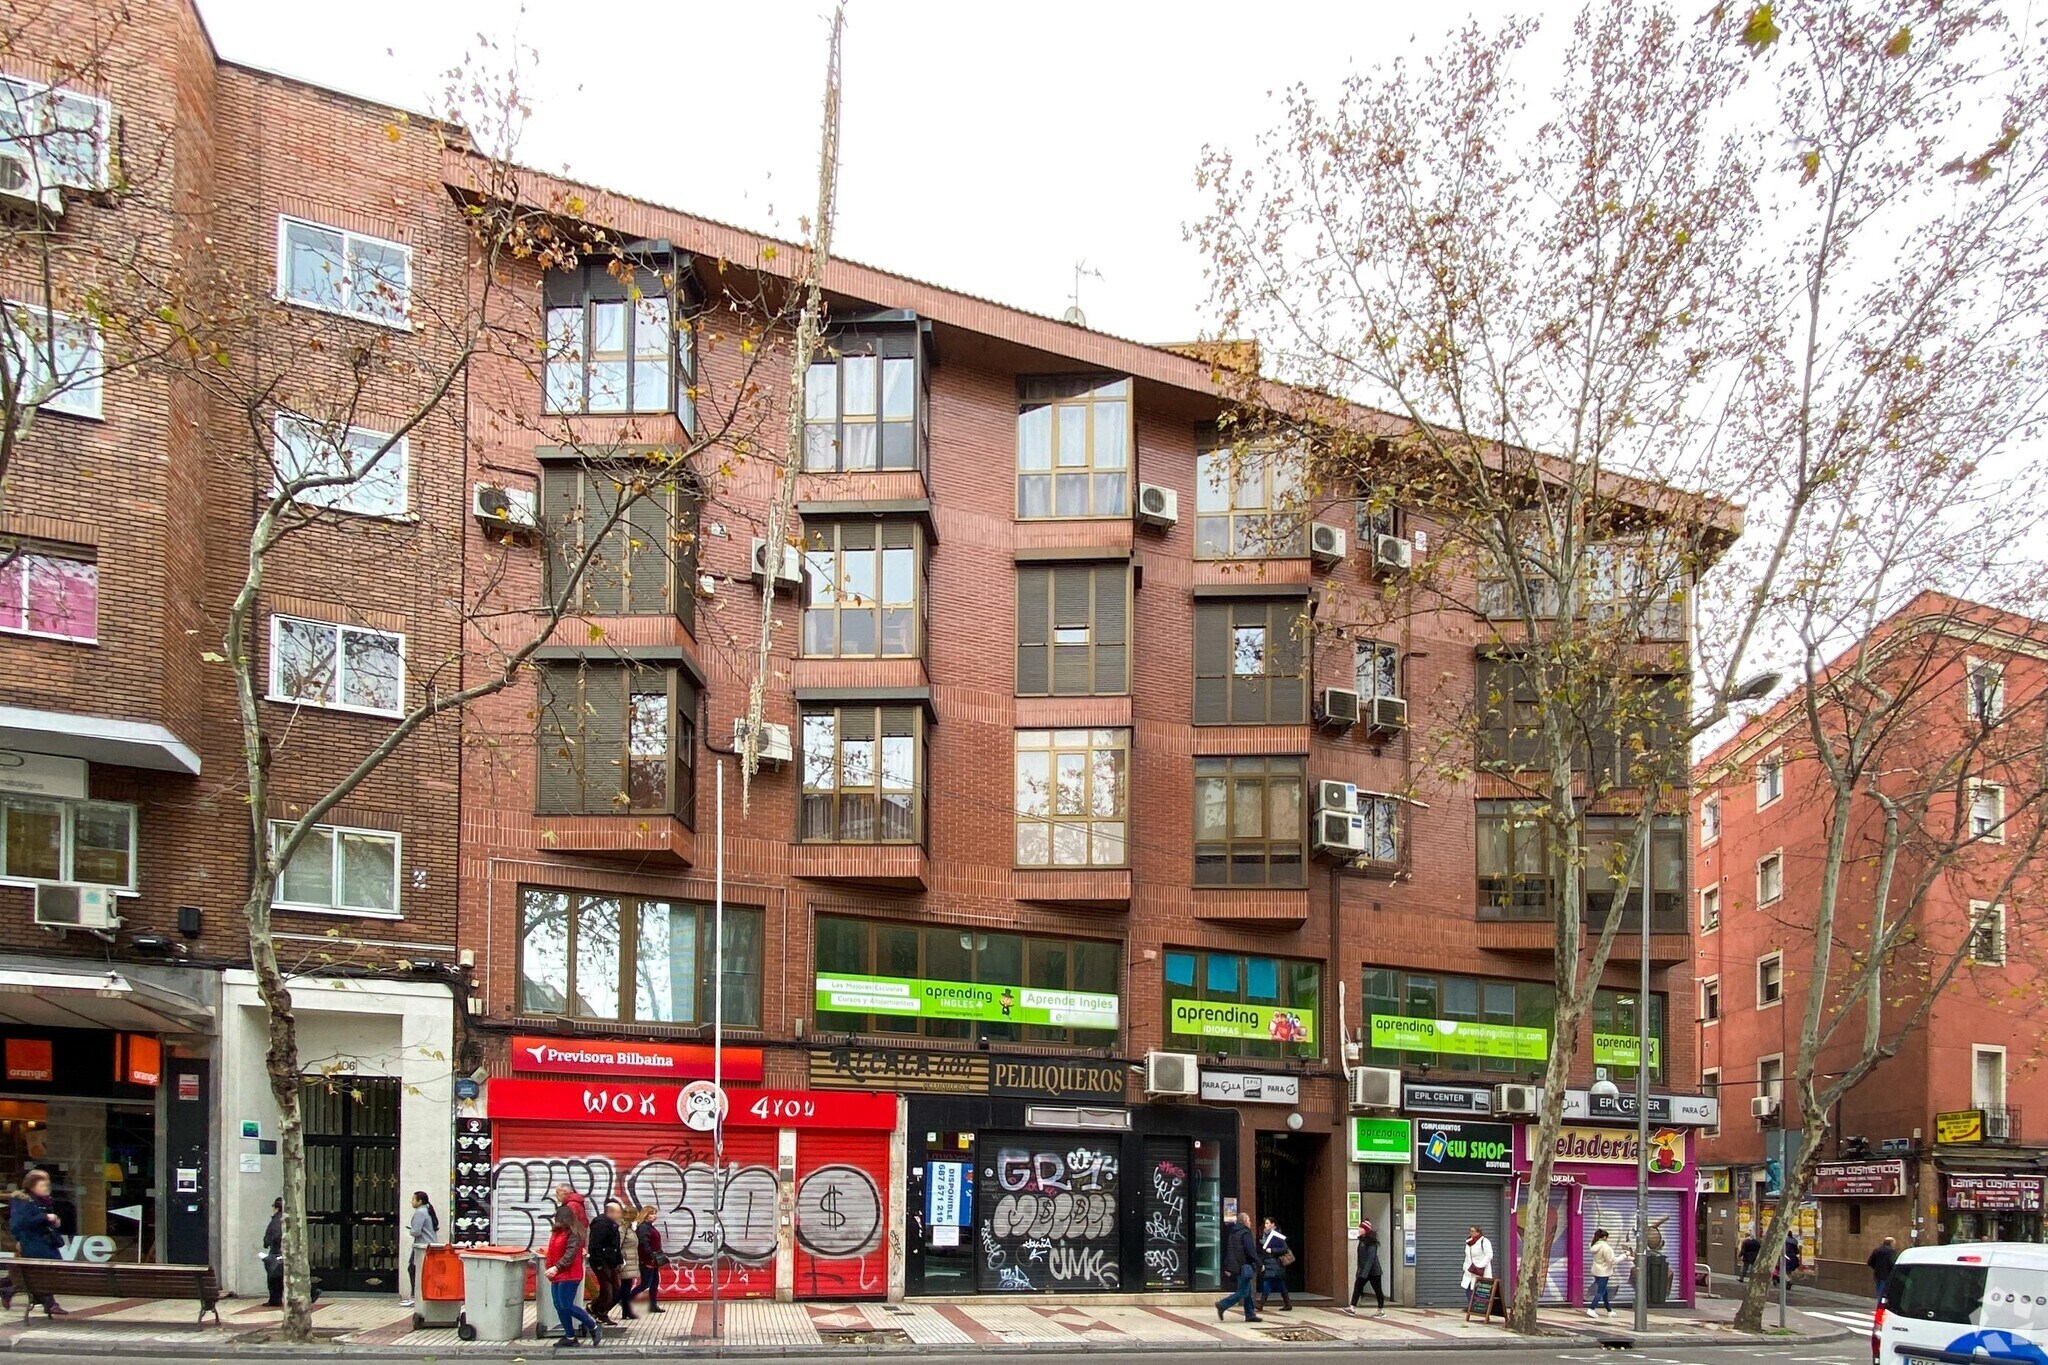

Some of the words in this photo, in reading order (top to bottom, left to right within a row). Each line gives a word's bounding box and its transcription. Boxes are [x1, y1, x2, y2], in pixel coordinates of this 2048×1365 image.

[837, 995, 861, 1004] Cursos
[926, 986, 993, 1003] aprending
[1027, 993, 1075, 1006] Aprende
[1177, 1006, 1259, 1029] aprending
[1203, 1024, 1240, 1036] IDIOMAS
[1376, 1018, 1434, 1036] aprending
[1596, 1037, 1640, 1050] aprendin
[547, 1049, 614, 1064] Previsora
[617, 1052, 674, 1067] Bilbaína
[829, 1049, 932, 1083] ALCALA
[9, 1068, 49, 1080] orange
[133, 1070, 159, 1083] orange
[994, 1063, 1123, 1096] PELUQUEROS
[1202, 1081, 1220, 1089] PARA
[1267, 1085, 1285, 1093] PARA
[582, 1089, 657, 1116] WOK
[1414, 1091, 1432, 1100] EPIL
[1433, 1093, 1465, 1102] CENTER
[749, 1096, 816, 1119] 4YOU
[1599, 1097, 1616, 1108] EPI
[1622, 1099, 1660, 1110] CEER
[1681, 1106, 1698, 1114] PARA
[1421, 1122, 1461, 1132] COMPLEMENTOS
[1360, 1128, 1407, 1140] aprending
[1470, 1141, 1505, 1160] SHOP
[1555, 1131, 1639, 1159] eladería
[938, 1164, 946, 1182] 687
[1846, 1164, 1901, 1175] COSMETICOS
[1550, 1174, 1576, 1183] ADERÍA
[1986, 1180, 2040, 1190] COSMETICOS
[937, 1185, 945, 1201] 571
[946, 1168, 955, 1220] DISPONIBLE
